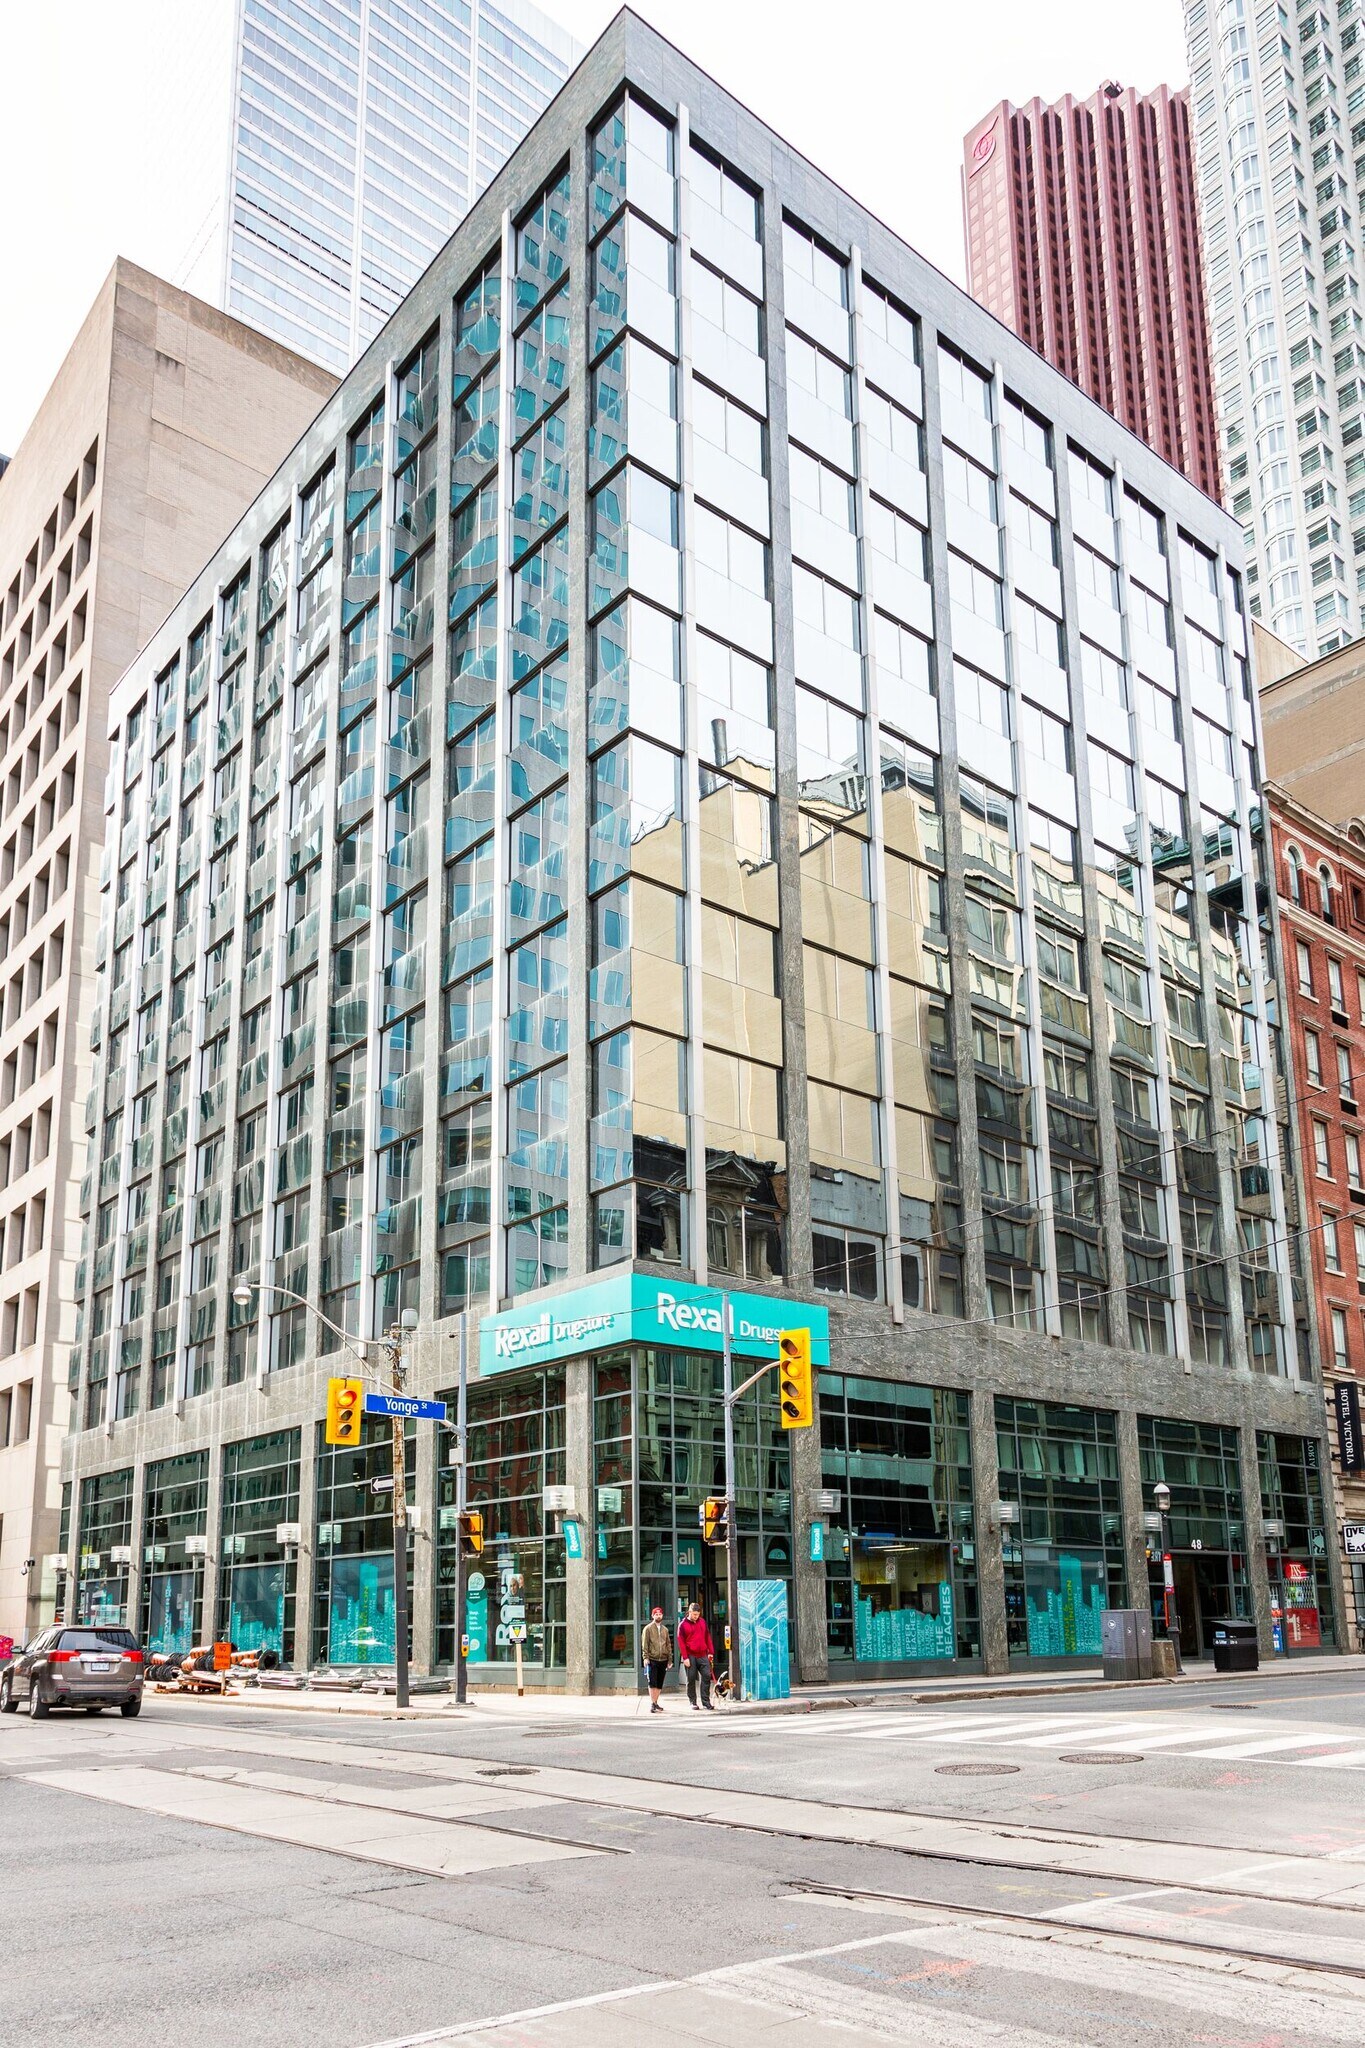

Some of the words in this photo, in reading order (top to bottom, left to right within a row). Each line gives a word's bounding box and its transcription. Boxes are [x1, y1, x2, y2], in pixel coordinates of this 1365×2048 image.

[657, 1292, 735, 1335] Rexal
[740, 1319, 785, 1344] Drugs
[495, 1312, 552, 1358] Rexall
[554, 1315, 614, 1340] Drugstore
[385, 1397, 419, 1415] Yonge
[421, 1402, 428, 1410] St
[1340, 1388, 1350, 1419] HOTEL
[1344, 1420, 1355, 1465] VICTORIA
[567, 1524, 579, 1553] Rexall
[813, 1527, 821, 1556] Rexall
[1191, 1539, 1203, 1549] 48
[677, 1547, 695, 1566] all
[942, 1586, 953, 1655] BEACHES
[1067, 1580, 1076, 1652] WELLINGTON
[936, 1626, 944, 1655] THE
